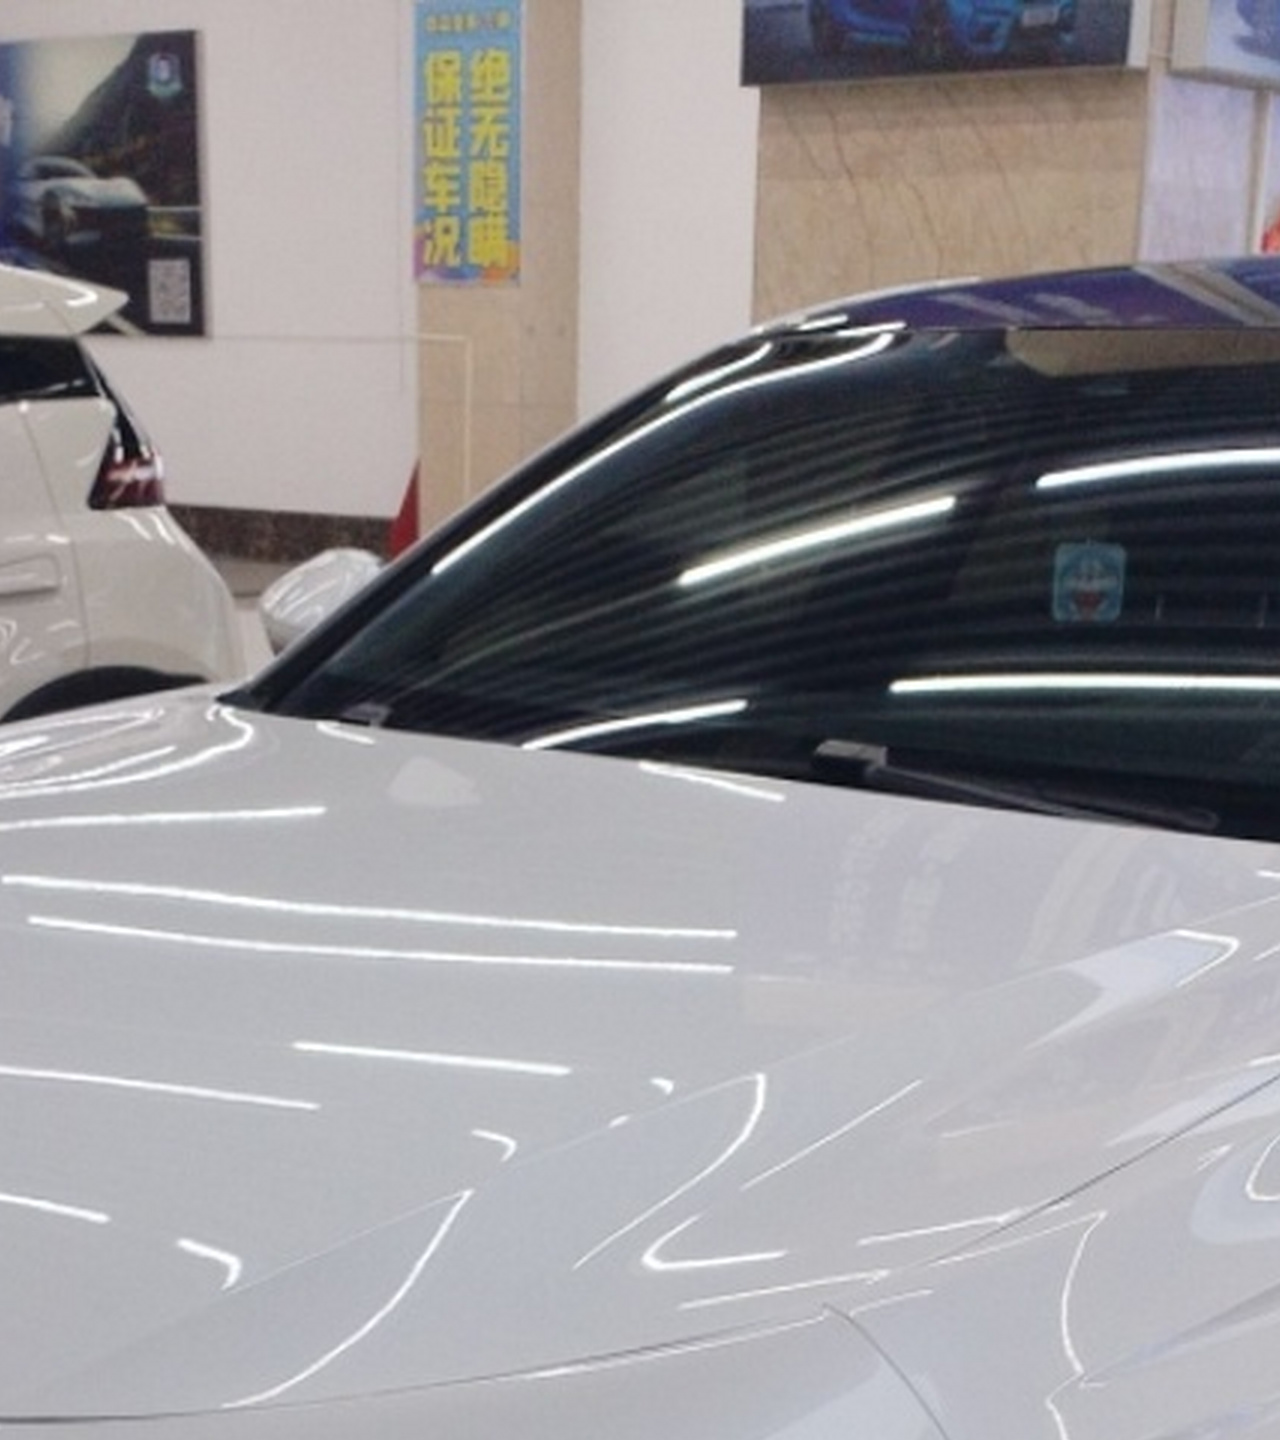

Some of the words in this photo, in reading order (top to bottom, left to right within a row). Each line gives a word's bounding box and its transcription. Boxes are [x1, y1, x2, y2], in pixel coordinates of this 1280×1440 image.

[424, 50, 461, 266] 保证车况
[470, 49, 510, 266] 绝无隐瞒
